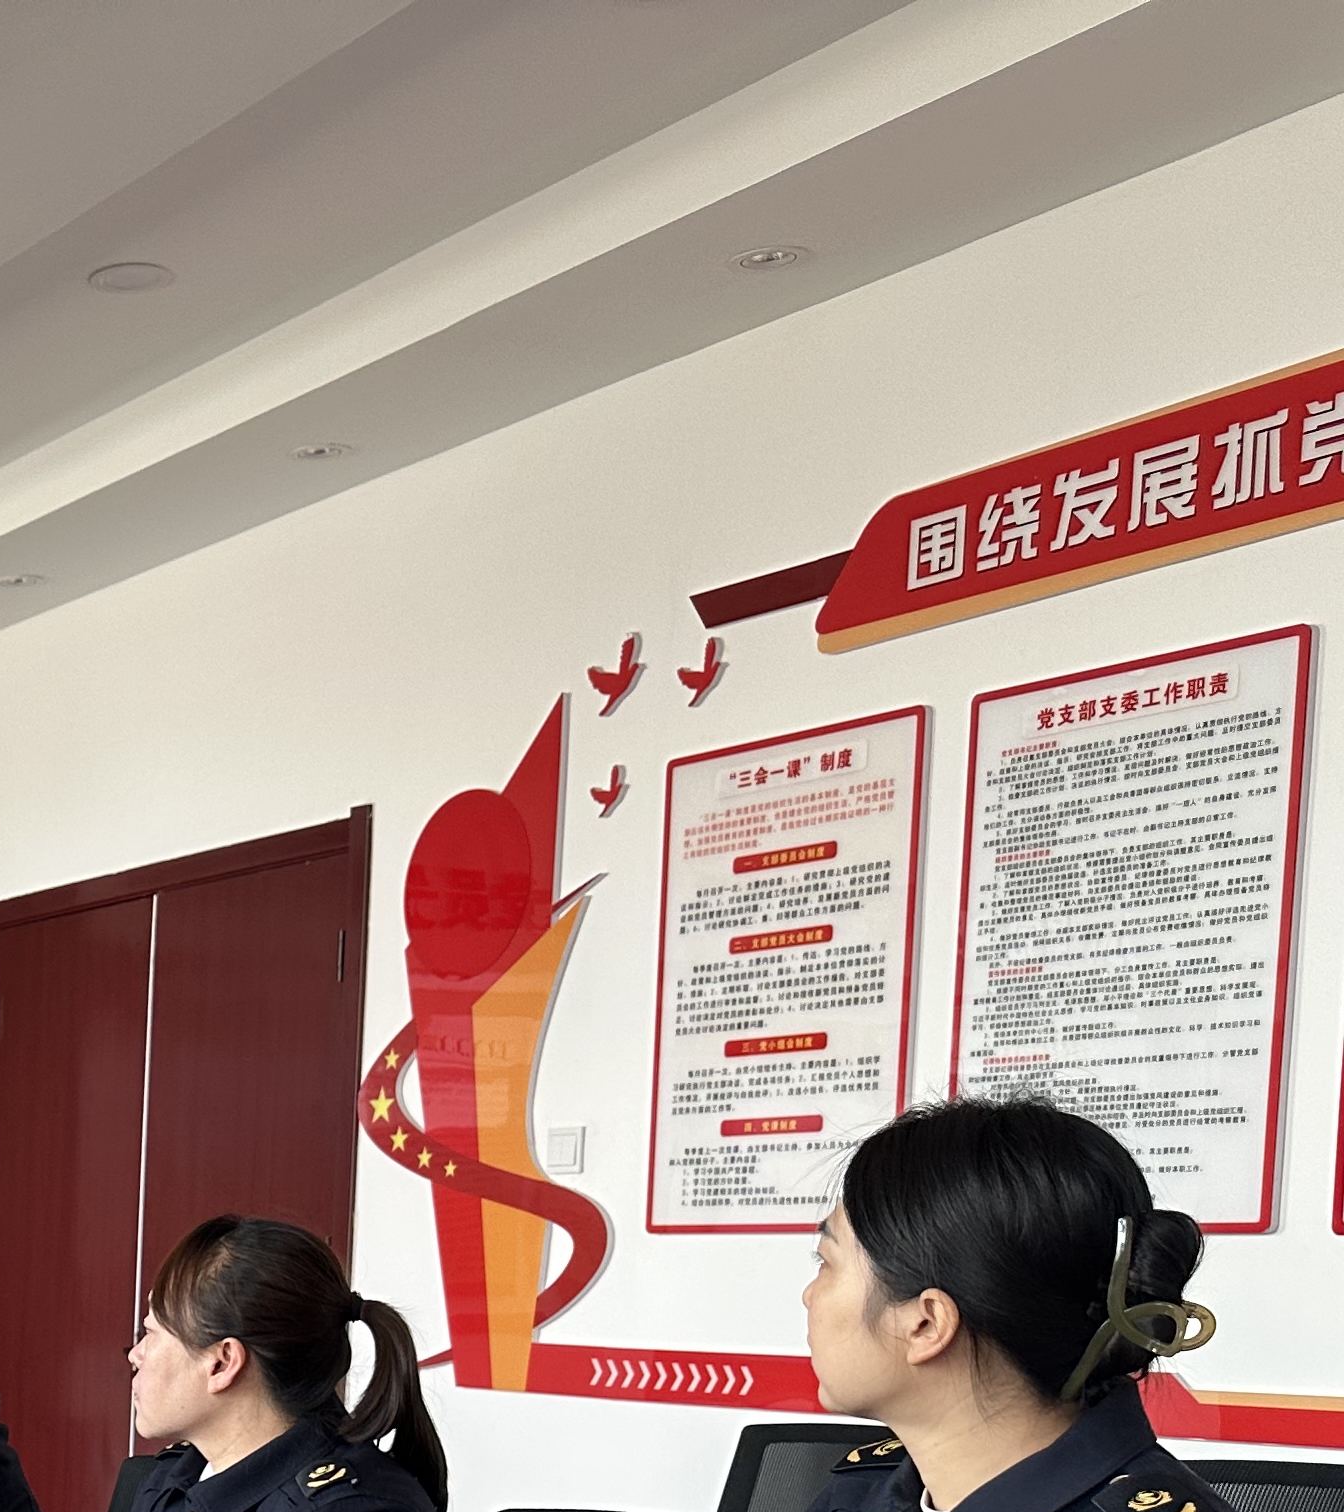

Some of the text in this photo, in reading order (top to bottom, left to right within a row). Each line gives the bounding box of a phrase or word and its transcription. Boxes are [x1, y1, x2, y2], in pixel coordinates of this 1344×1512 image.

[905, 392, 1344, 592] 围绕发展抓党
[1035, 671, 1231, 731] 党支部支委工作职责
